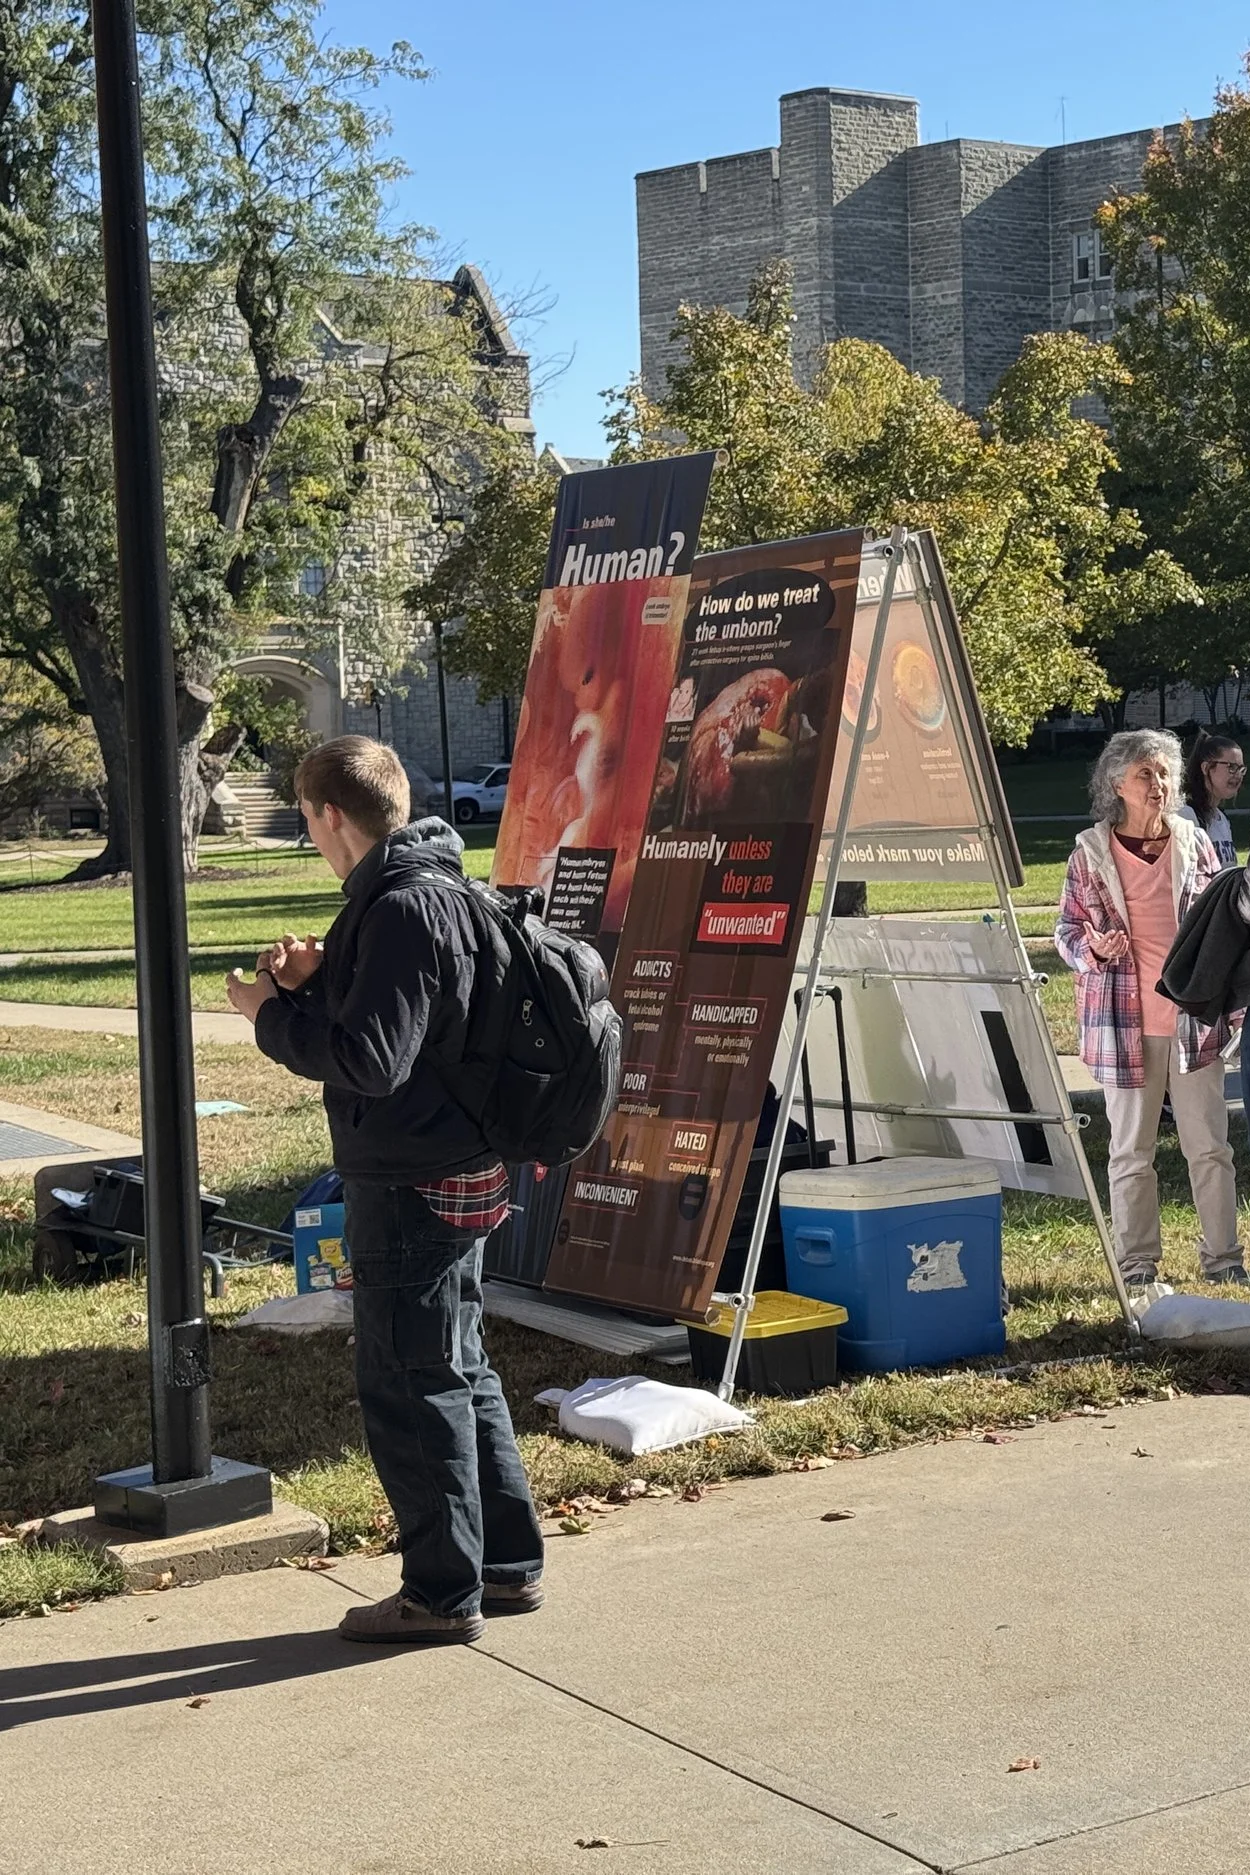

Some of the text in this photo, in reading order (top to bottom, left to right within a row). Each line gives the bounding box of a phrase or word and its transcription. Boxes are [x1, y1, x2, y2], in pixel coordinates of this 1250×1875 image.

[582, 518, 589, 529] Is
[559, 531, 685, 587] Human?
[699, 583, 820, 616] How do we treat
[695, 613, 782, 642] the unborn?
[641, 834, 773, 866] Humanely unless
[722, 869, 774, 899] they are
[704, 909, 786, 936] "unwanted"
[658, 992, 667, 1000] or
[692, 1004, 758, 1025] HANDICAPPED
[623, 1073, 647, 1090] POOR
[674, 1131, 707, 1151] HATED
[668, 1160, 700, 1175] conceived
[574, 1181, 638, 1206] INCONVENIENT
